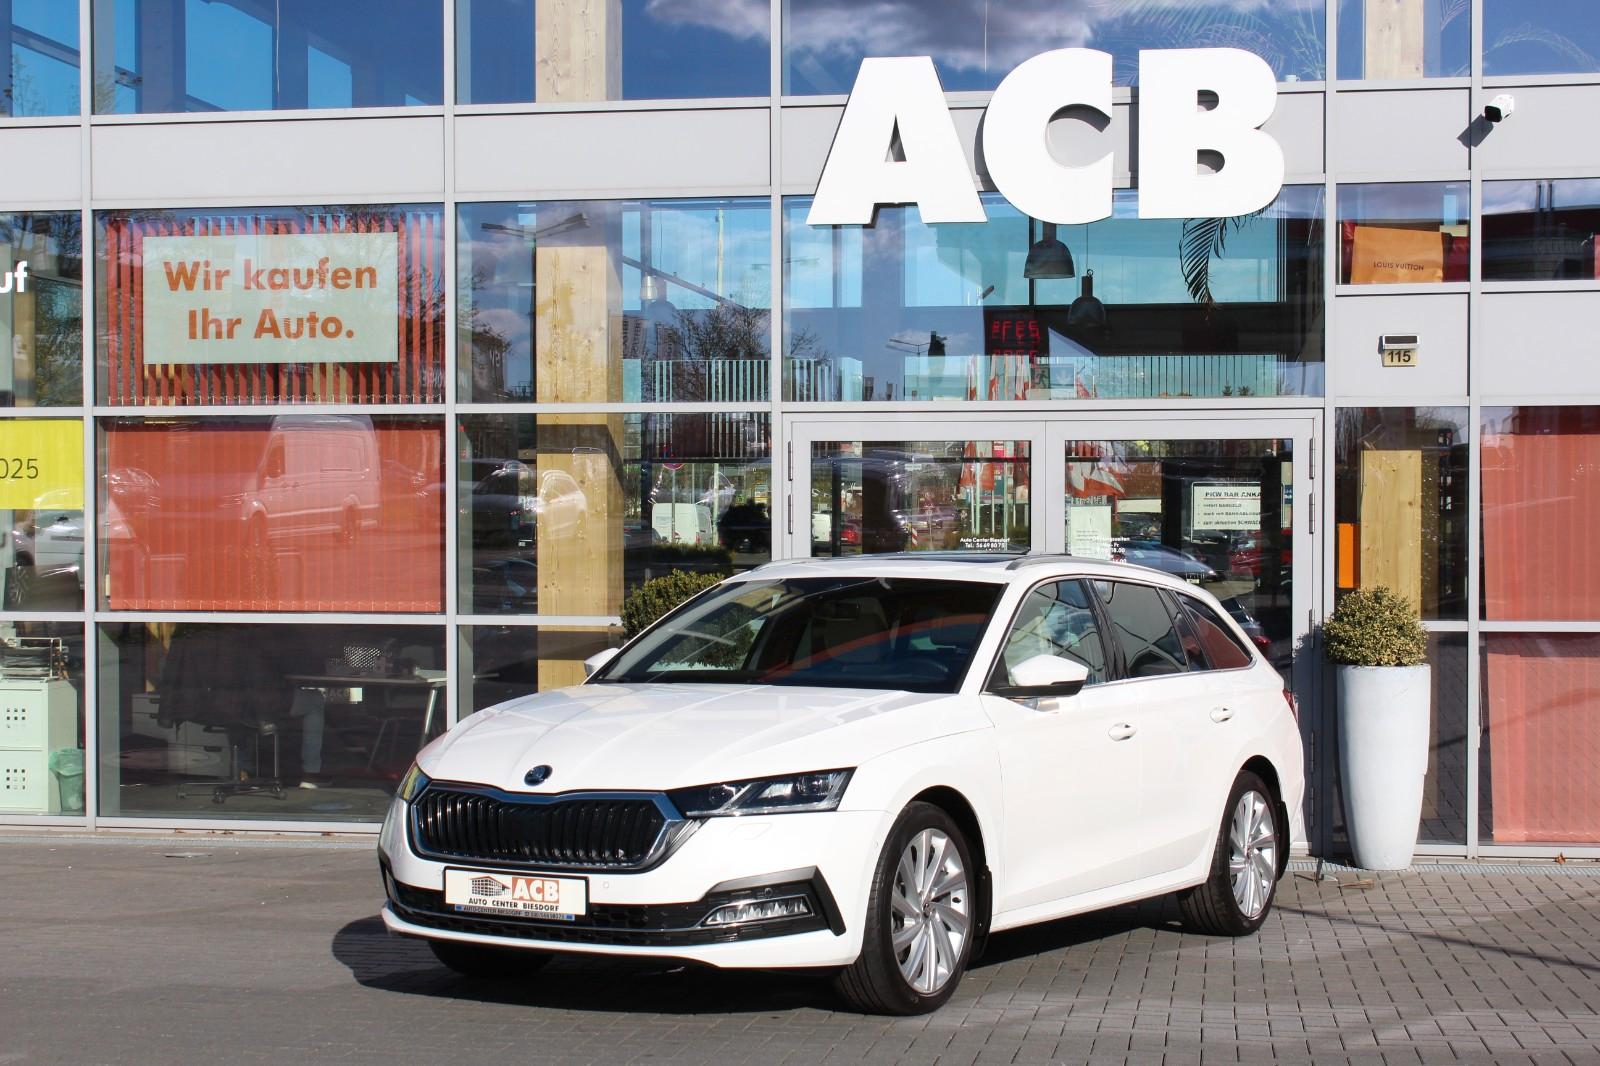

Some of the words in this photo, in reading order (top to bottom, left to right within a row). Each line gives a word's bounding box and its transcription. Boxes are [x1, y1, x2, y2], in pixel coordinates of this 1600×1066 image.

[806, 47, 1285, 226] ACB
[164, 261, 230, 292] Wir
[244, 257, 377, 292] kaufen
[1373, 261, 1394, 269] LOUIS
[1395, 262, 1425, 271] VUITTON
[188, 308, 242, 340] Ihr
[253, 308, 355, 340] Auto.
[1388, 350, 1411, 363] 115
[513, 878, 559, 902] ACB
[492, 900, 518, 908] CENTER
[522, 902, 560, 912] BIESDORF
